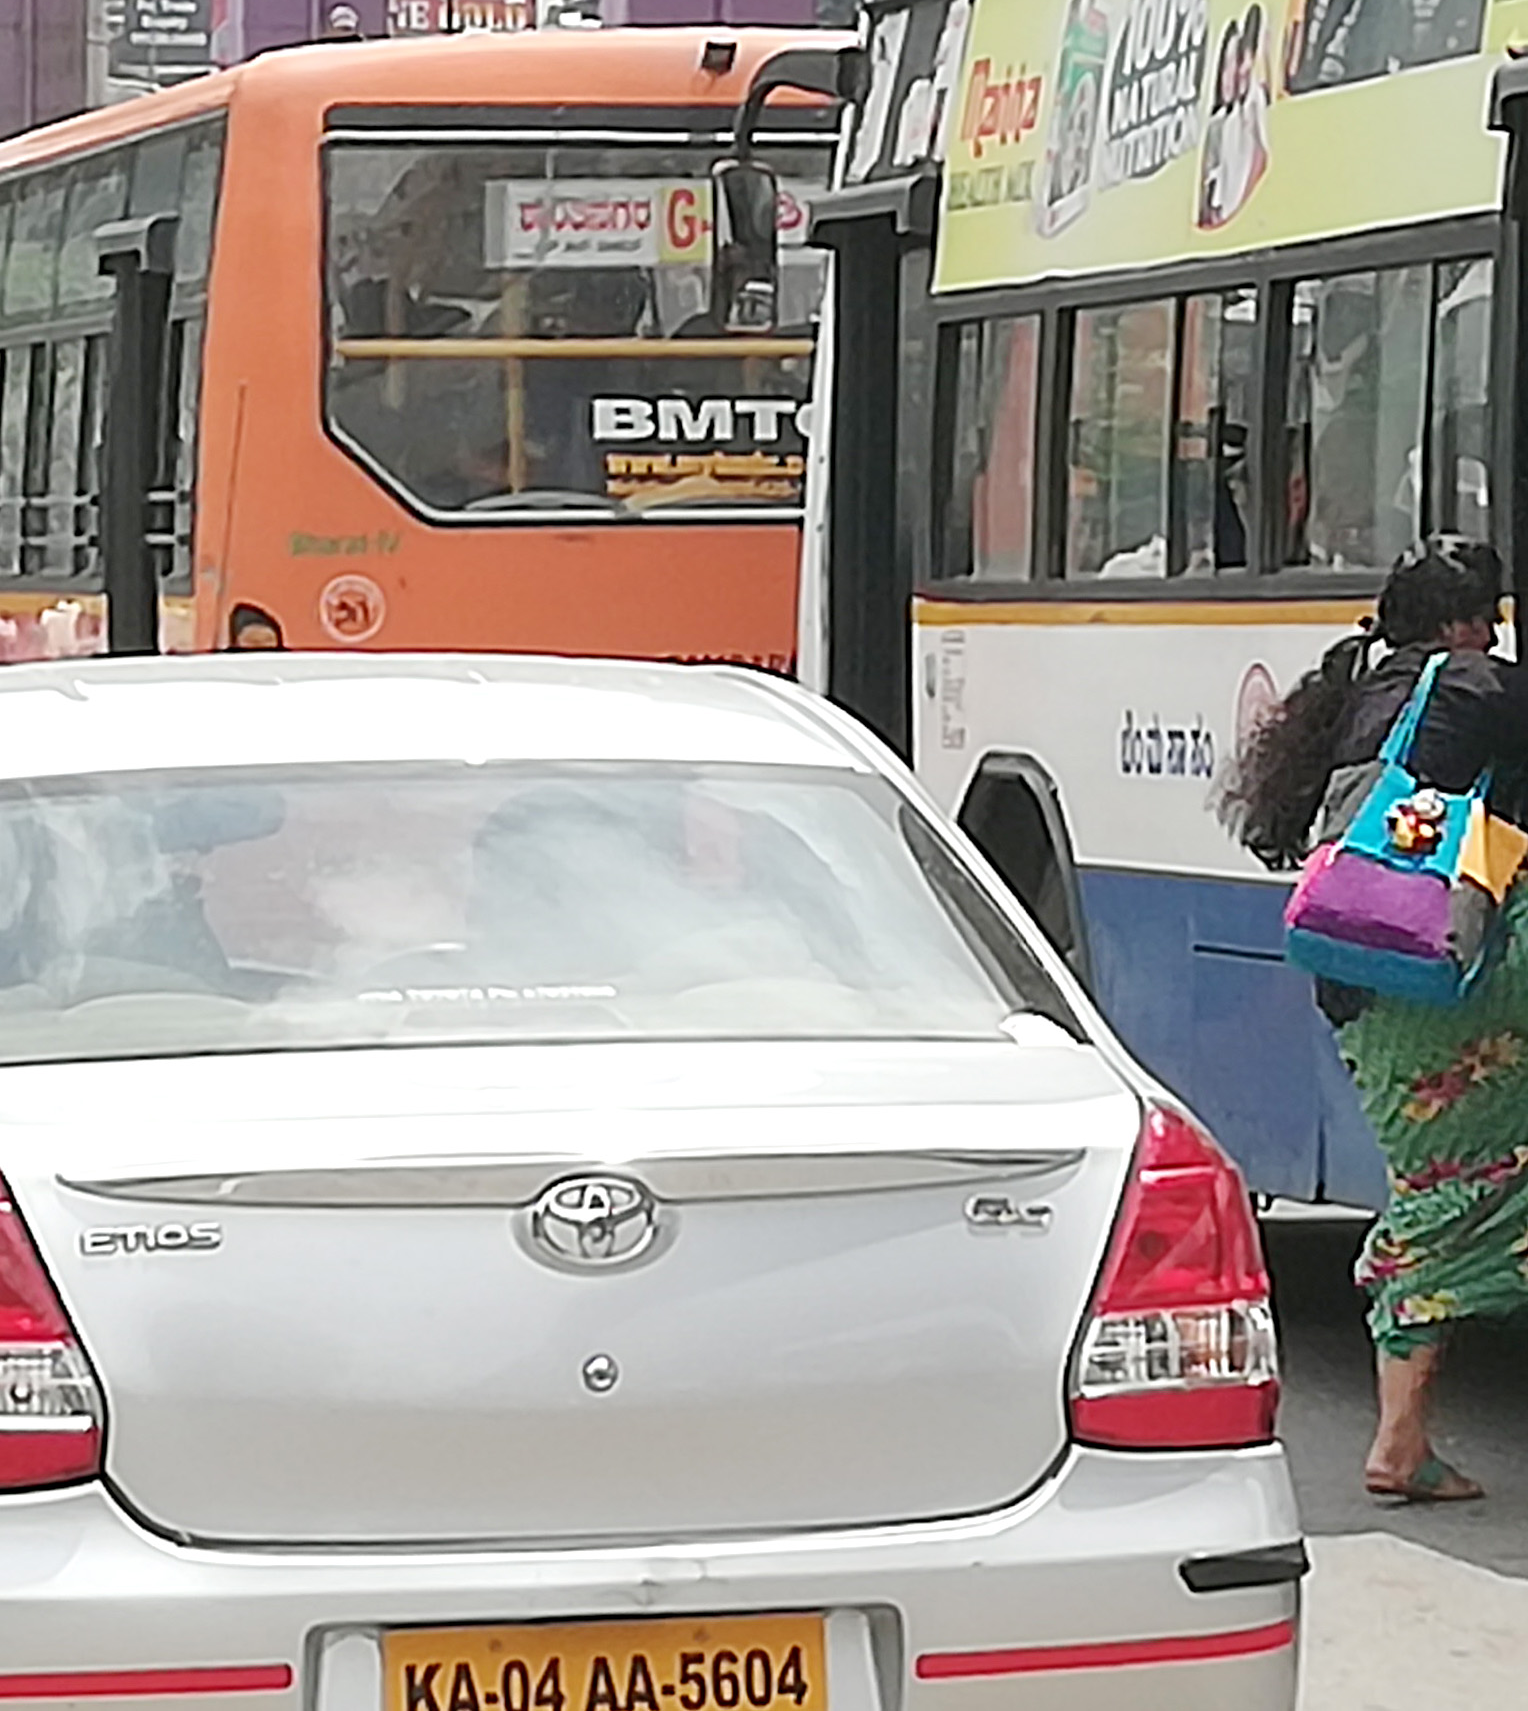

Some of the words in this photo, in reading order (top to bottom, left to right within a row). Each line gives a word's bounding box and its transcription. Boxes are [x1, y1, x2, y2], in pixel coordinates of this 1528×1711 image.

[1111, 50, 1199, 140] NATURAL
[79, 1222, 223, 1256] ETIOS
[404, 1656, 566, 1711] KA-04
[585, 1644, 809, 1711] AA-5604
